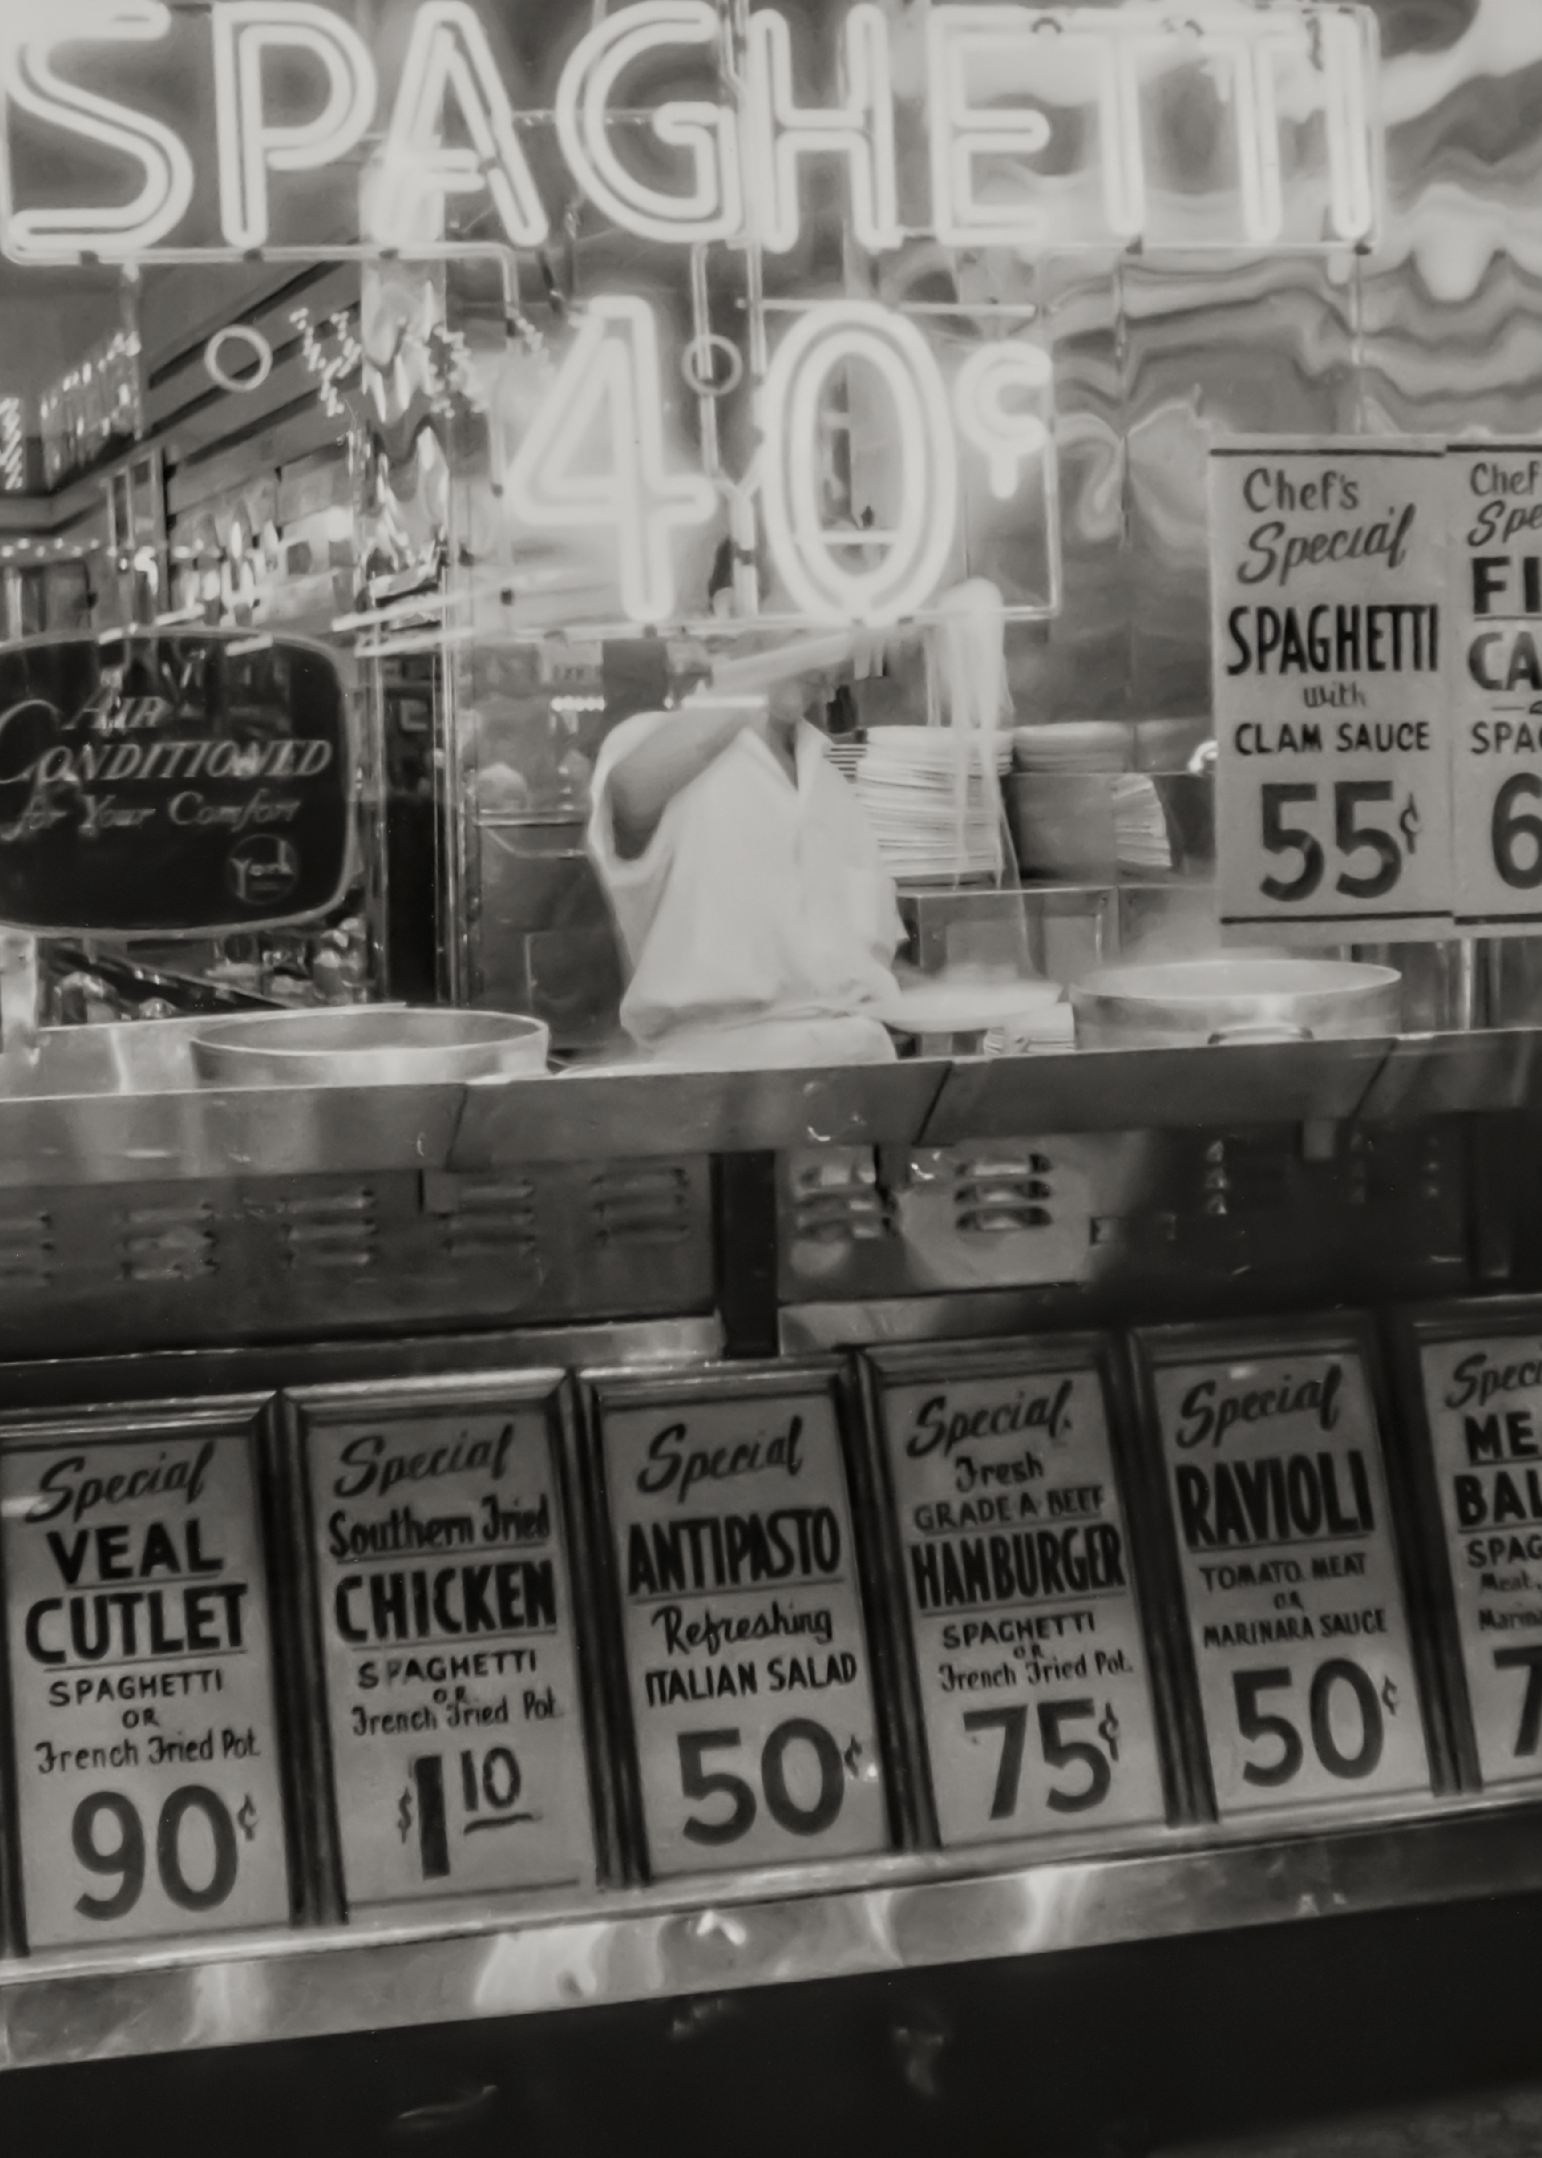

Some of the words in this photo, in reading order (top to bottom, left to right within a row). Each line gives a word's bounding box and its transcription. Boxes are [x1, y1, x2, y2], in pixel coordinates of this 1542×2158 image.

[3, 0, 1372, 255] SPAGHETTI
[1243, 467, 1360, 512] Chef's
[1236, 503, 1417, 586] Special
[1226, 604, 1439, 676] SPAGHETTI
[1303, 680, 1367, 709] with
[1234, 721, 1323, 756] CLAM
[1336, 721, 1431, 753] SAUCE
[1175, 1363, 1342, 1449] Special
[24, 1441, 216, 1524] Special
[333, 1424, 514, 1498] Special
[636, 1416, 804, 1503] Special
[955, 1451, 1044, 1493] Fresh
[914, 1496, 1011, 1531] GRADE
[1020, 1491, 1038, 1517] A
[1046, 1484, 1103, 1516] BEEF
[1175, 1449, 1376, 1553] RAVIOLI
[328, 1506, 474, 1559] Southern
[481, 1493, 549, 1542] Fried
[46, 1519, 225, 1586] VEAL
[628, 1507, 841, 1595] ANTIPASTO
[911, 1523, 1126, 1610] HAMBURGER
[1311, 1553, 1366, 1581] MEAT
[25, 1582, 249, 1665] CUTLET
[335, 1559, 557, 1643] CHICKEN
[1273, 1591, 1304, 1610] OR
[651, 1600, 833, 1656] Refreshing
[943, 1611, 1095, 1649] SPAGHETTI
[1013, 1644, 1044, 1659] OR
[1203, 1615, 1315, 1649] MARINARA
[1320, 1608, 1387, 1638] SAUCE
[50, 1669, 224, 1707] SPAGHETTI
[358, 1649, 536, 1688] SPAGHETTI
[646, 1661, 758, 1707] ITALIAN
[768, 1652, 858, 1691] SALAD
[939, 1662, 1017, 1692] French
[1025, 1653, 1087, 1685] Fried
[122, 1707, 160, 1729] OR
[352, 1706, 437, 1736] French
[446, 1696, 508, 1727] Fried
[433, 1686, 469, 1703] OR
[35, 1738, 139, 1774] French
[148, 1728, 213, 1765] Fried
